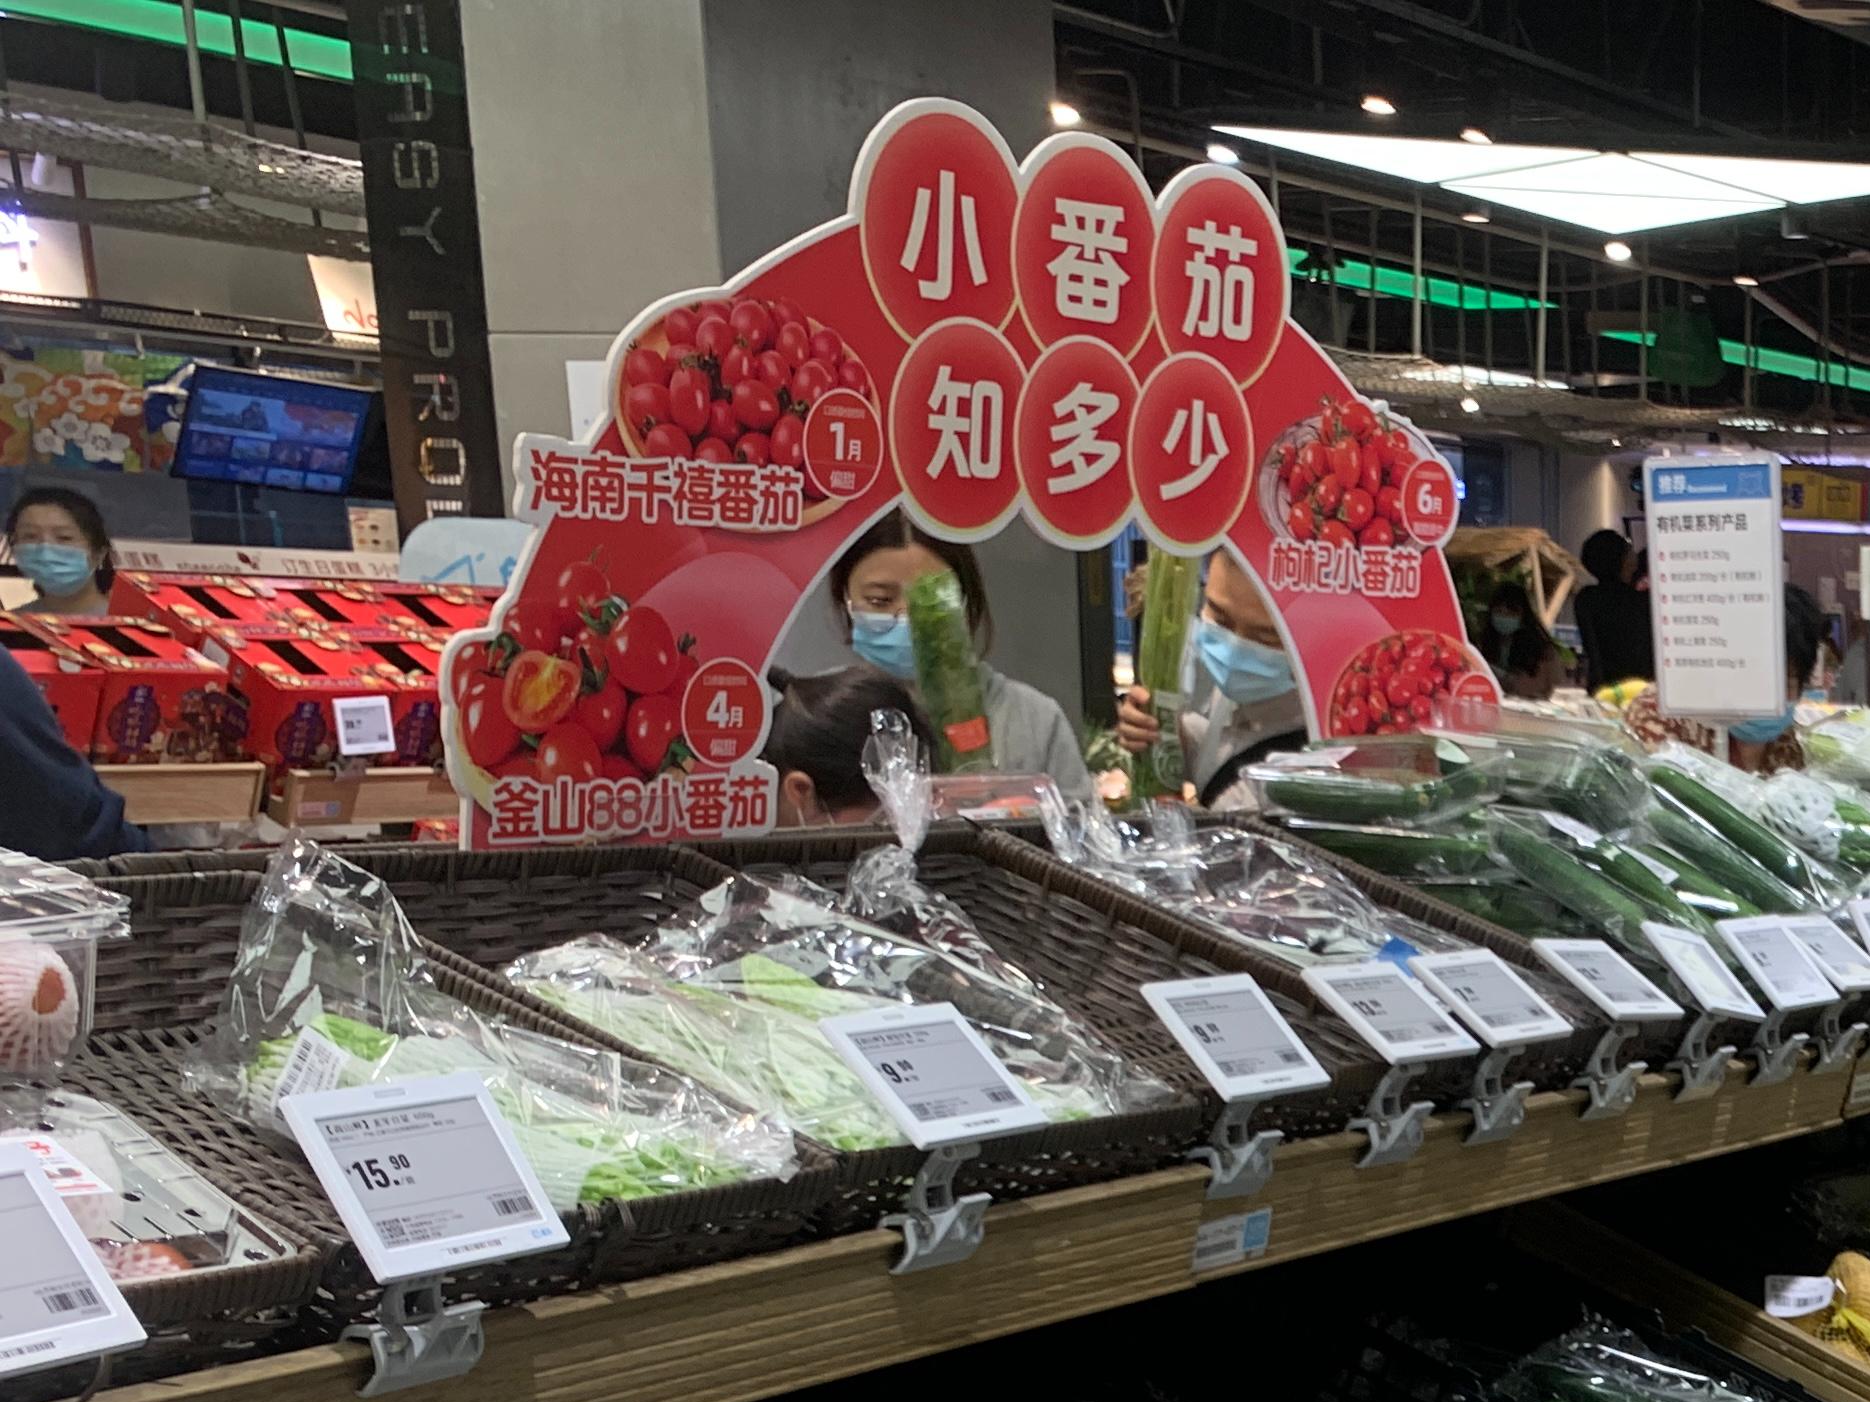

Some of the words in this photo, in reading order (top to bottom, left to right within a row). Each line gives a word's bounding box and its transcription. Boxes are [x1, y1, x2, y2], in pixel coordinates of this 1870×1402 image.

[900, 170, 1258, 342] 小番茄
[407, 310, 468, 519] PRO
[829, 421, 861, 462] 1月
[926, 366, 1230, 502] 知多少
[529, 448, 802, 527] 海南千禧番茄
[1656, 512, 1748, 534] 有机菜系列产品
[1271, 541, 1420, 595] 枸杞小番茄
[706, 690, 744, 729] 4月
[492, 774, 770, 837] 釜山88小番茄
